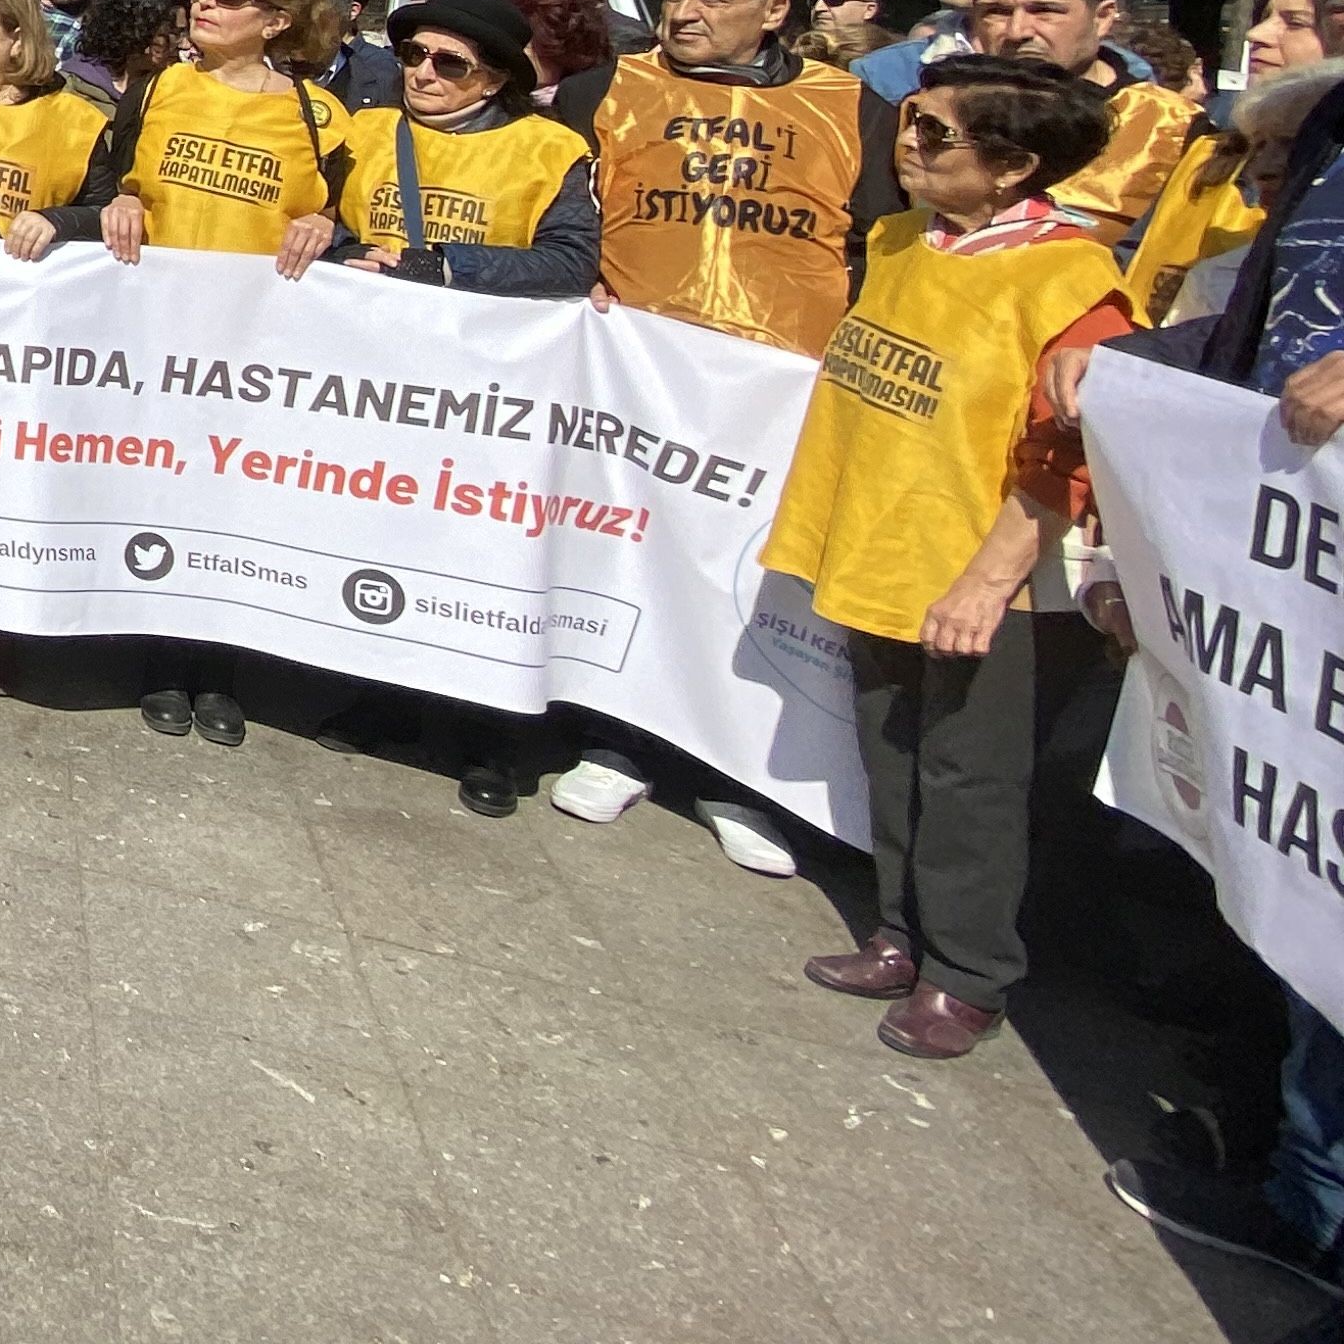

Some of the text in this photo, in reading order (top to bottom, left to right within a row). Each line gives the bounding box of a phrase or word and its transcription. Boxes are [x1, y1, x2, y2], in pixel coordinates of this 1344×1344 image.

[663, 115, 796, 160] ETFAL'İ
[158, 159, 281, 204] KAPATILMASIN!
[164, 137, 284, 184] ŞİŞLİ ETFAL
[681, 152, 773, 192] GERİ
[424, 193, 488, 226] ETFAL
[869, 337, 943, 393] ETFAL
[160, 354, 535, 442] HASTANEMİZ
[547, 402, 768, 508] NEREDE!
[14, 421, 187, 475] Hemen,
[207, 434, 419, 506] Yerinde
[433, 457, 651, 543] İstiyoruz!
[186, 551, 309, 590] EtfalSmas
[755, 612, 808, 642] ŞİŞLİ
[1159, 573, 1288, 714] AMA
